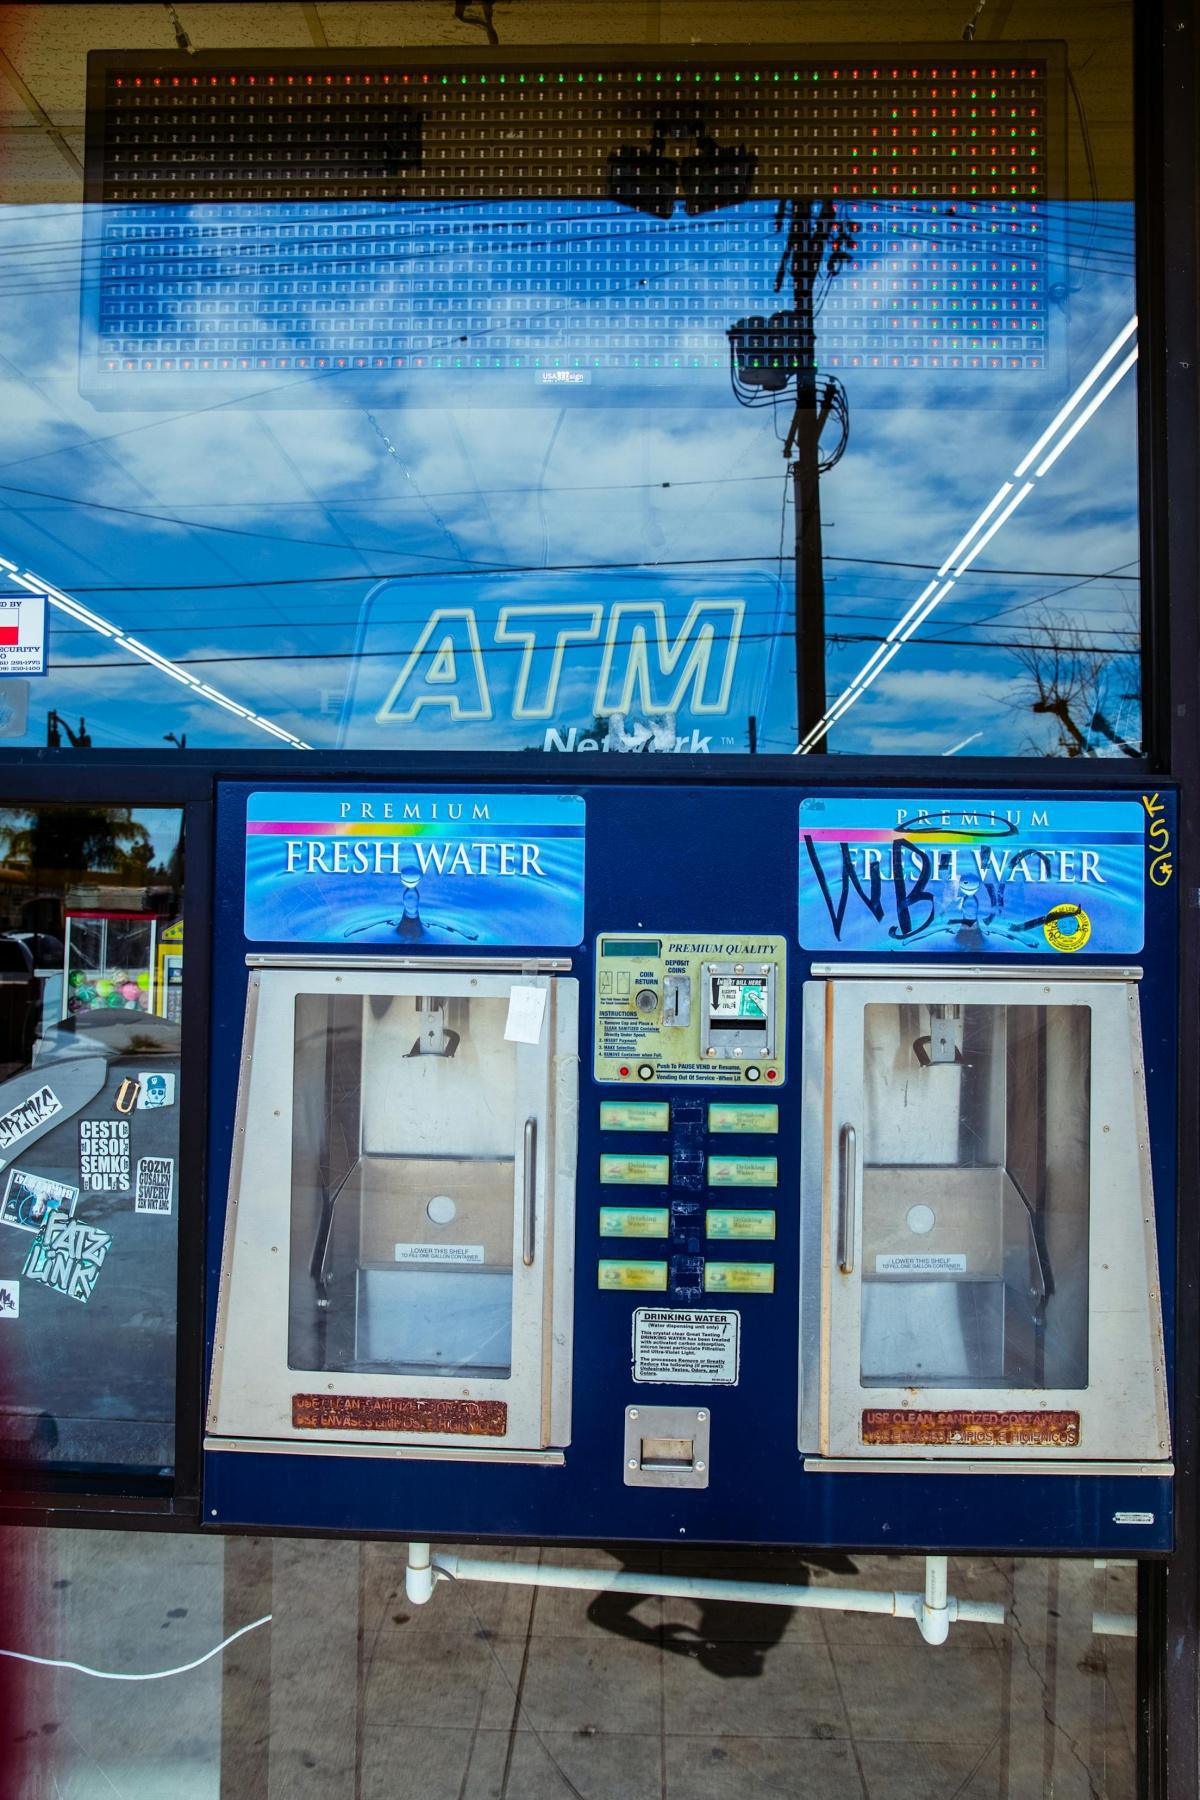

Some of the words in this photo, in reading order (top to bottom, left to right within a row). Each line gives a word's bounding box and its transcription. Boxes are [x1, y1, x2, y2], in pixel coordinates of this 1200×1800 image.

[376, 599, 746, 723] ATM
[340, 802, 491, 819] PREMIUM
[897, 808, 1050, 827] PREMIUM
[285, 841, 401, 874] FRESH
[415, 842, 547, 876] WATER
[846, 847, 958, 881] FRESH
[973, 848, 1106, 883] WATER
[669, 943, 723, 953] PREMIUM
[725, 944, 777, 955] QUALITY
[81, 1173, 130, 1191] TOLTS
[644, 1313, 692, 1321] DRINKING
[868, 1412, 889, 1424] USE
[893, 1413, 933, 1424] CLEAN
[938, 1413, 998, 1425] SANITIZED
